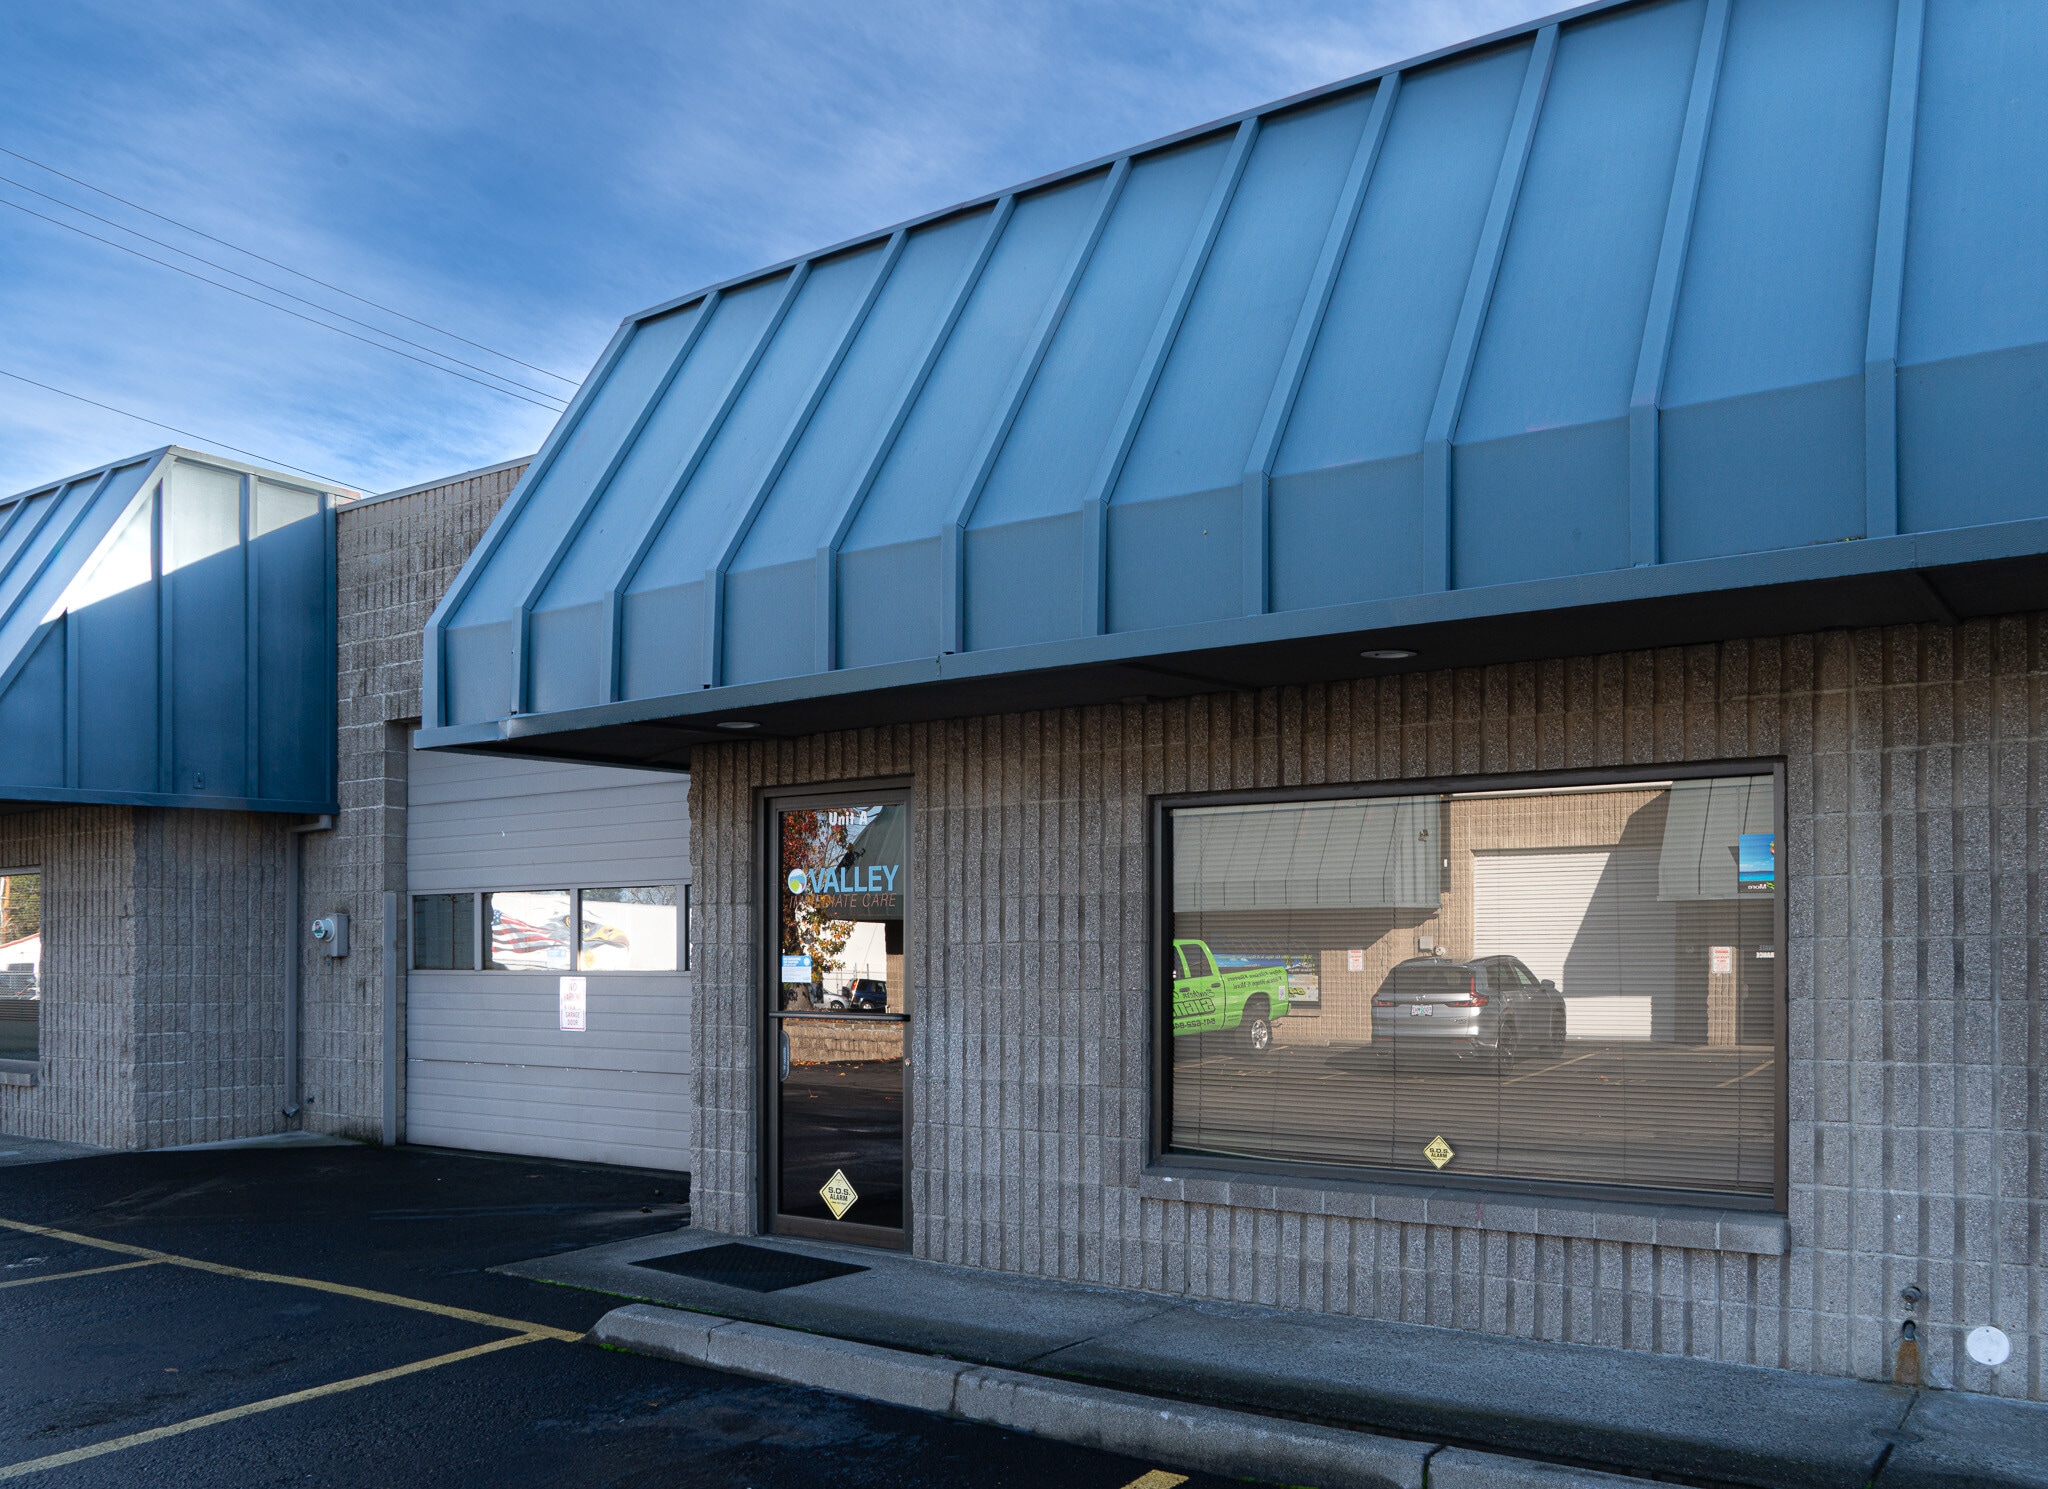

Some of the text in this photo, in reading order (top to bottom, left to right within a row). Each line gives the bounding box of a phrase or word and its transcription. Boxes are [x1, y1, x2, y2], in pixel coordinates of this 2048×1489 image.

[829, 811, 868, 825] Unit A
[809, 864, 899, 893] VALLEY
[862, 892, 897, 907] CARE
[568, 982, 578, 991] NO
